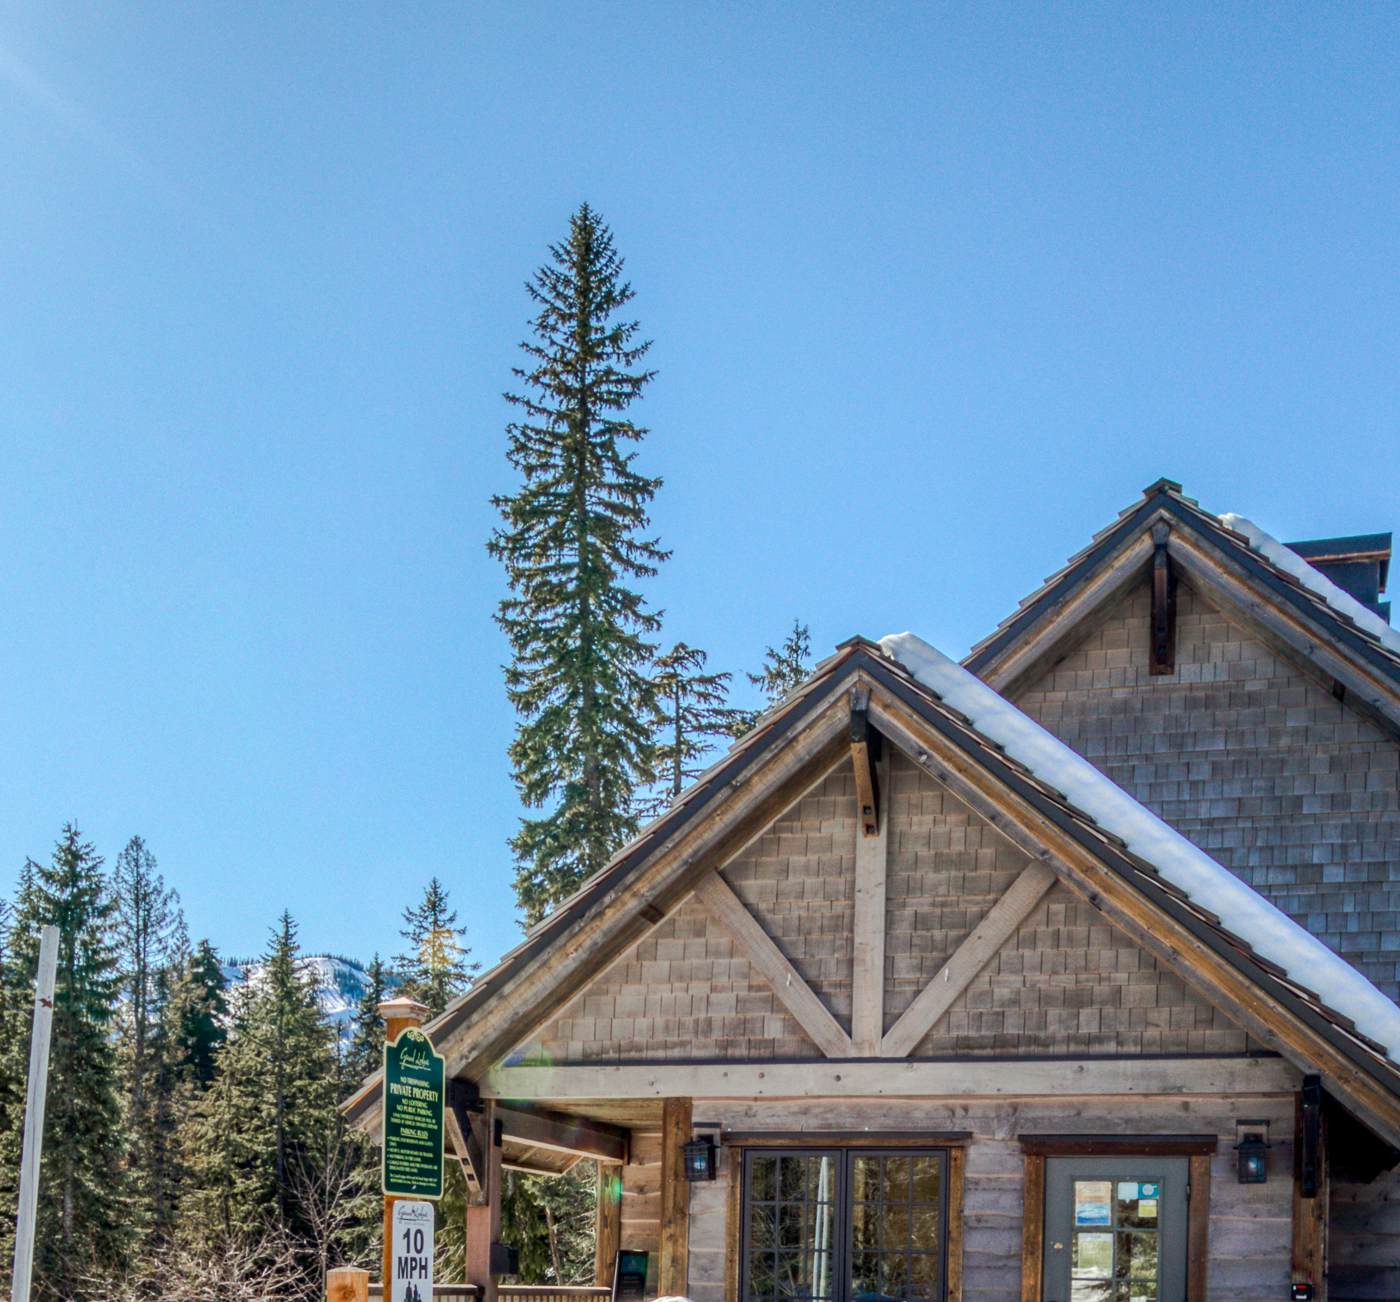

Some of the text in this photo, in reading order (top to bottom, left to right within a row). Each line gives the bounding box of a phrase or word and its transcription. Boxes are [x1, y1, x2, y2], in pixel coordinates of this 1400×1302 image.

[390, 1082, 438, 1102] PRIVATE PROPERTY
[403, 1228, 424, 1254] 10
[398, 1256, 428, 1280] MPH
